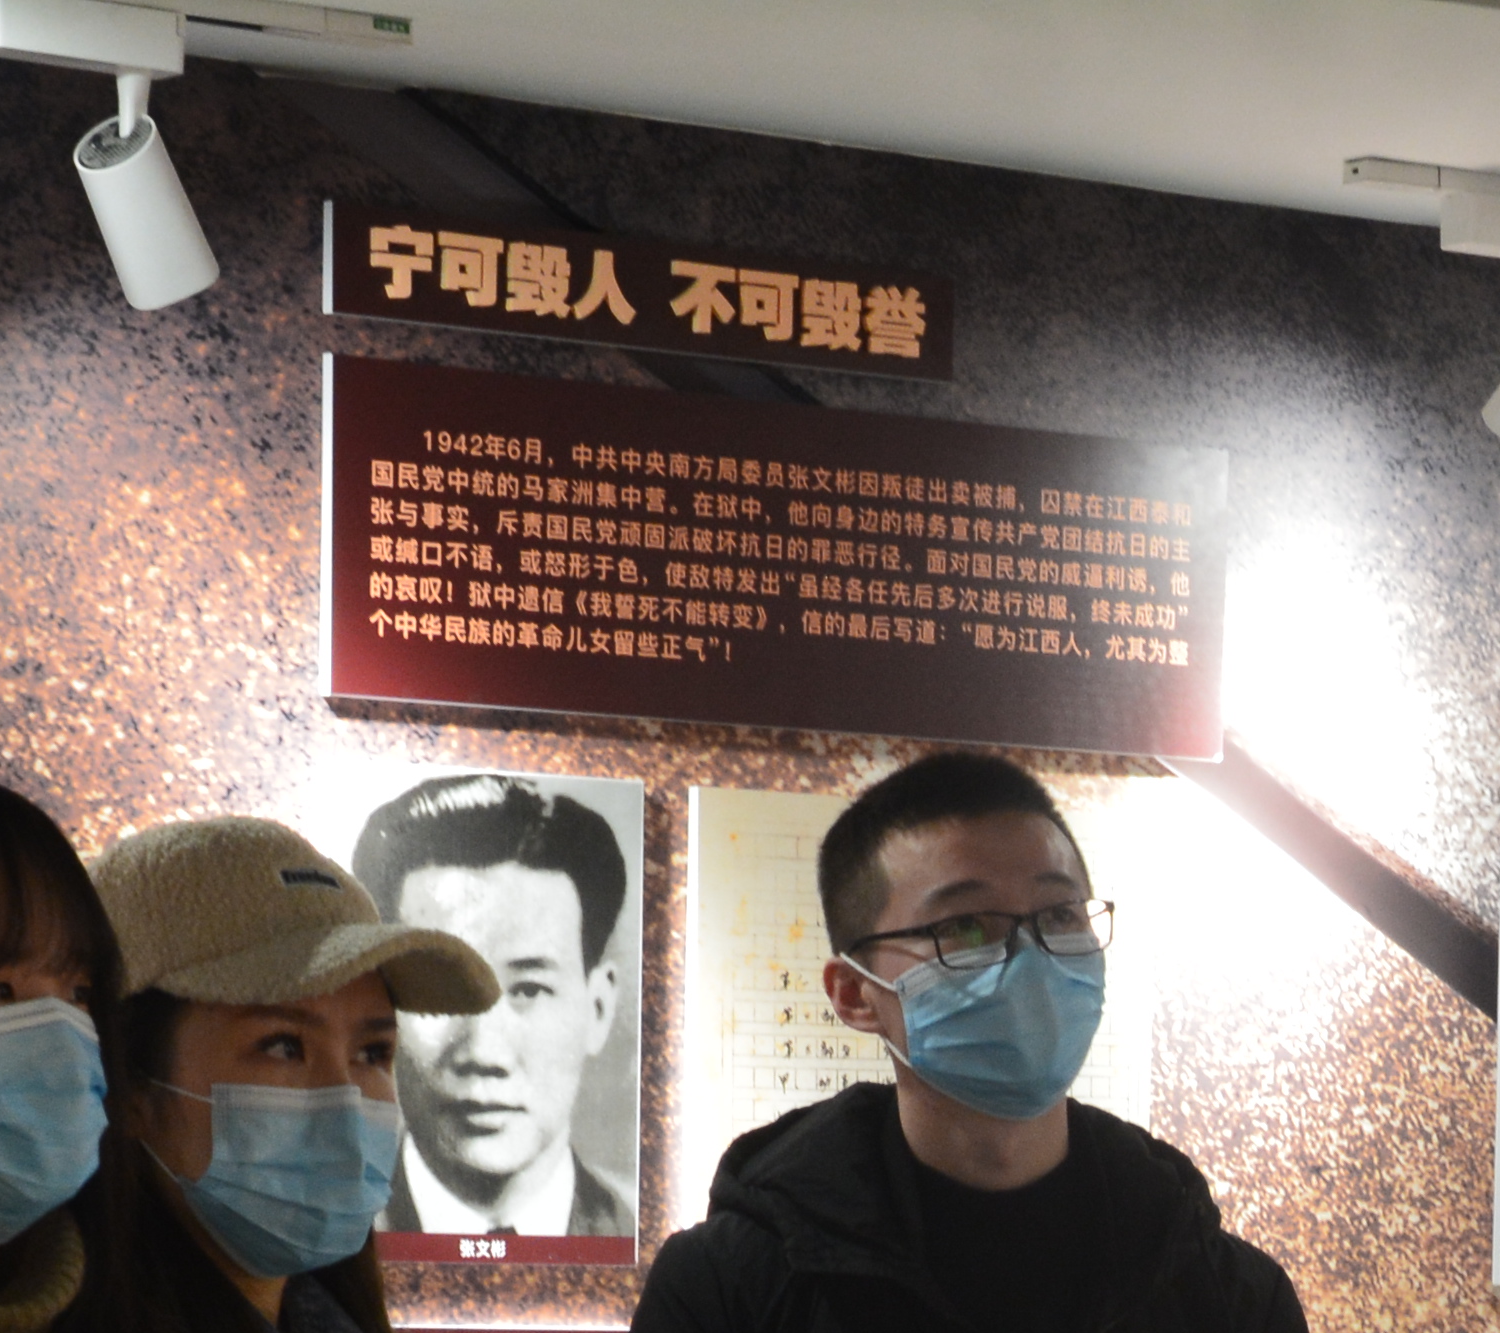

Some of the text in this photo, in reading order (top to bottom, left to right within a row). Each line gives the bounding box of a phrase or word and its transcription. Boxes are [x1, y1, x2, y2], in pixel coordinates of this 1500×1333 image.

[370, 225, 926, 358] 宁可毁人 不可毁誉
[459, 1238, 507, 1259] 张文彬
